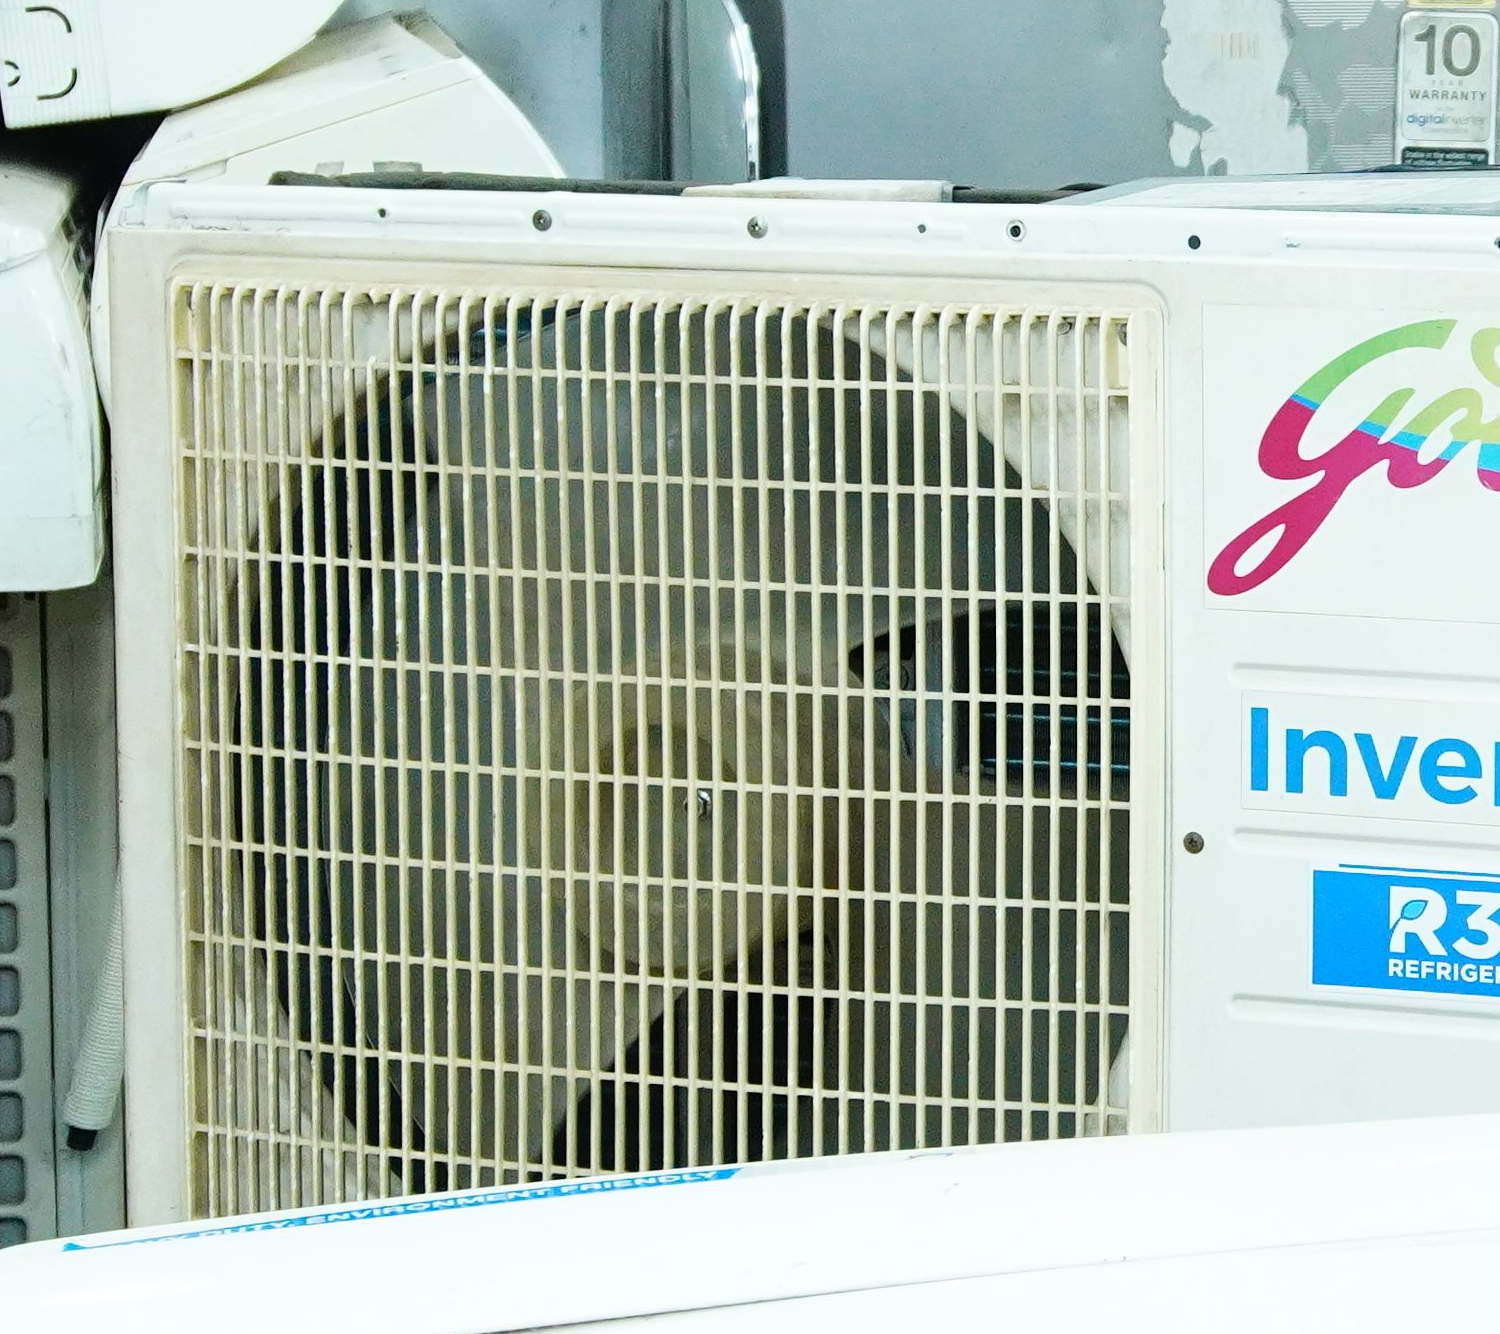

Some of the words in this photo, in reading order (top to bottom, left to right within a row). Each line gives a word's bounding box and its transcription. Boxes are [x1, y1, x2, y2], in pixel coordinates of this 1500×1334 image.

[1414, 24, 1481, 77] 10
[1408, 89, 1487, 101] WARRANTY
[305, 1188, 553, 1224] ENVIRONMENT
[560, 1170, 719, 1194] FRIENDLY
